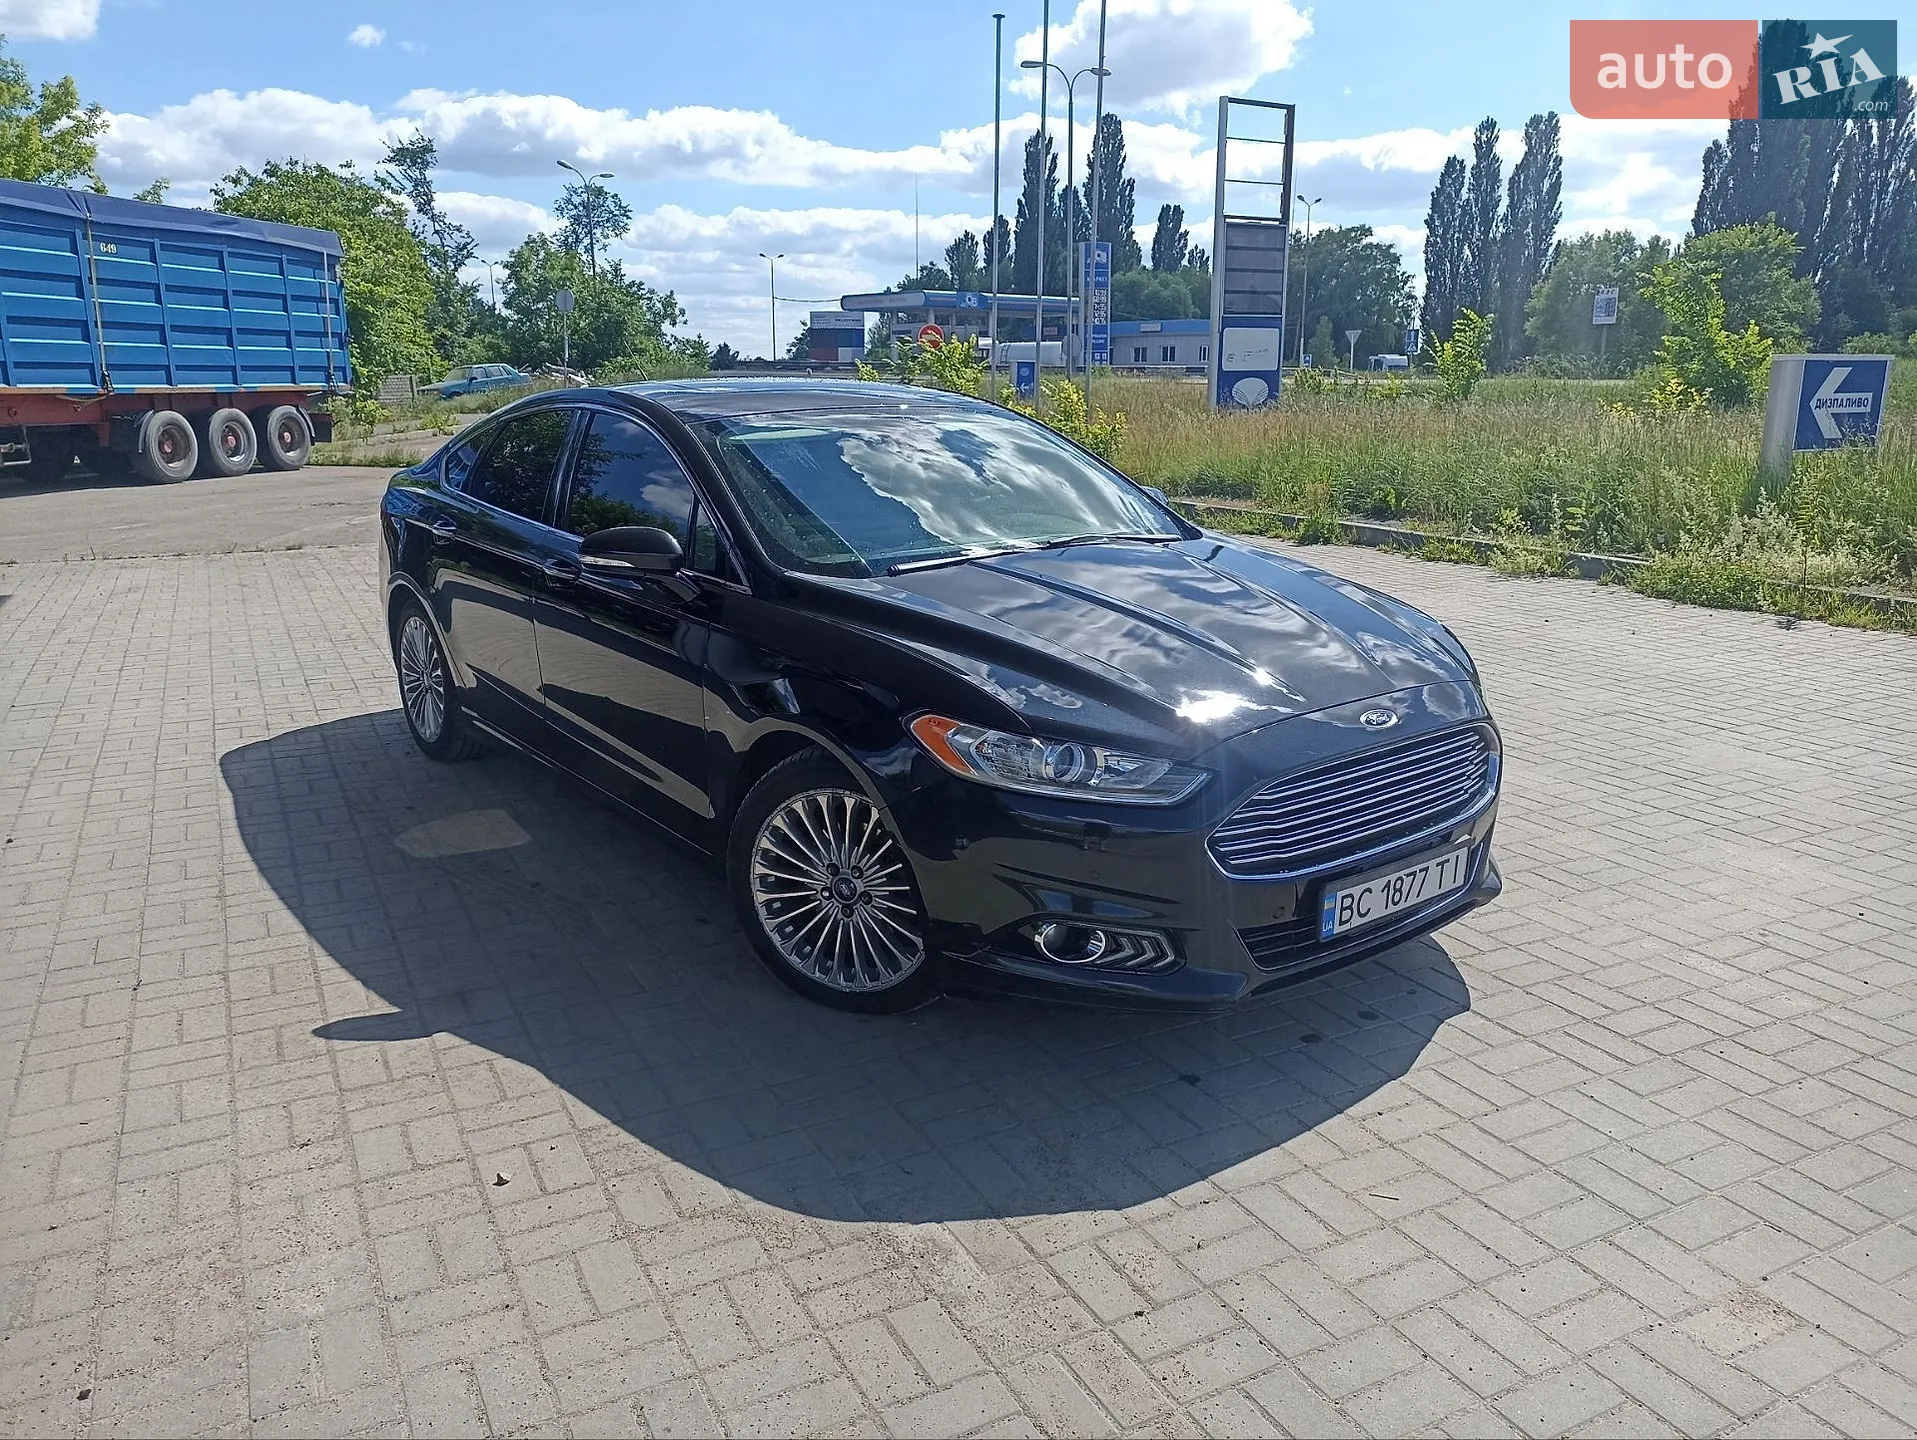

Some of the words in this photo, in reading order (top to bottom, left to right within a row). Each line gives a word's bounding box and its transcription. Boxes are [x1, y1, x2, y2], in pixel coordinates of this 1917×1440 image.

[1815, 397, 1869, 410] ДИЗПАЛИВО
[1338, 887, 1373, 927] BC
[1381, 866, 1430, 910] 1877
[1322, 921, 1334, 932] UA
